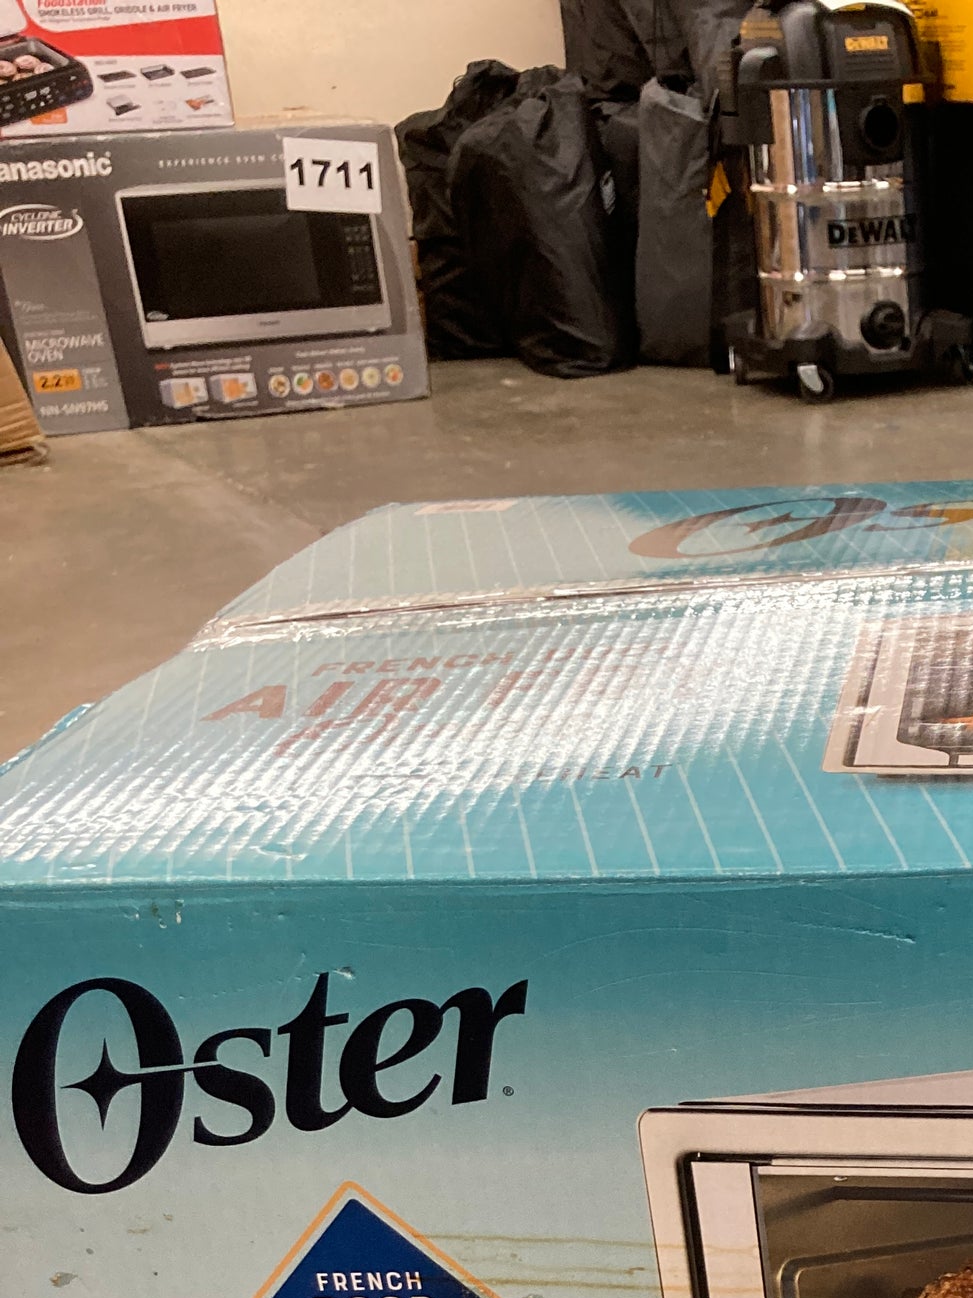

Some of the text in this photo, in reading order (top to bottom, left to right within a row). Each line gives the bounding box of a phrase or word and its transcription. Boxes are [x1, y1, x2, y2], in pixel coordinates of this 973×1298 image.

[38, 8, 86, 17] SMOKELESS
[114, 5, 147, 15] GRIDDLE
[149, 5, 155, 13] &
[157, 5, 170, 13] AIR
[172, 3, 198, 13] FRYER
[290, 157, 374, 190] 1711
[2, 217, 74, 236] INVERTER
[27, 349, 64, 364] OVEN
[311, 651, 515, 678] FRENCH
[200, 677, 443, 722] AIR
[11, 970, 529, 1195] Oster
[316, 1271, 423, 1292] FRENCH
